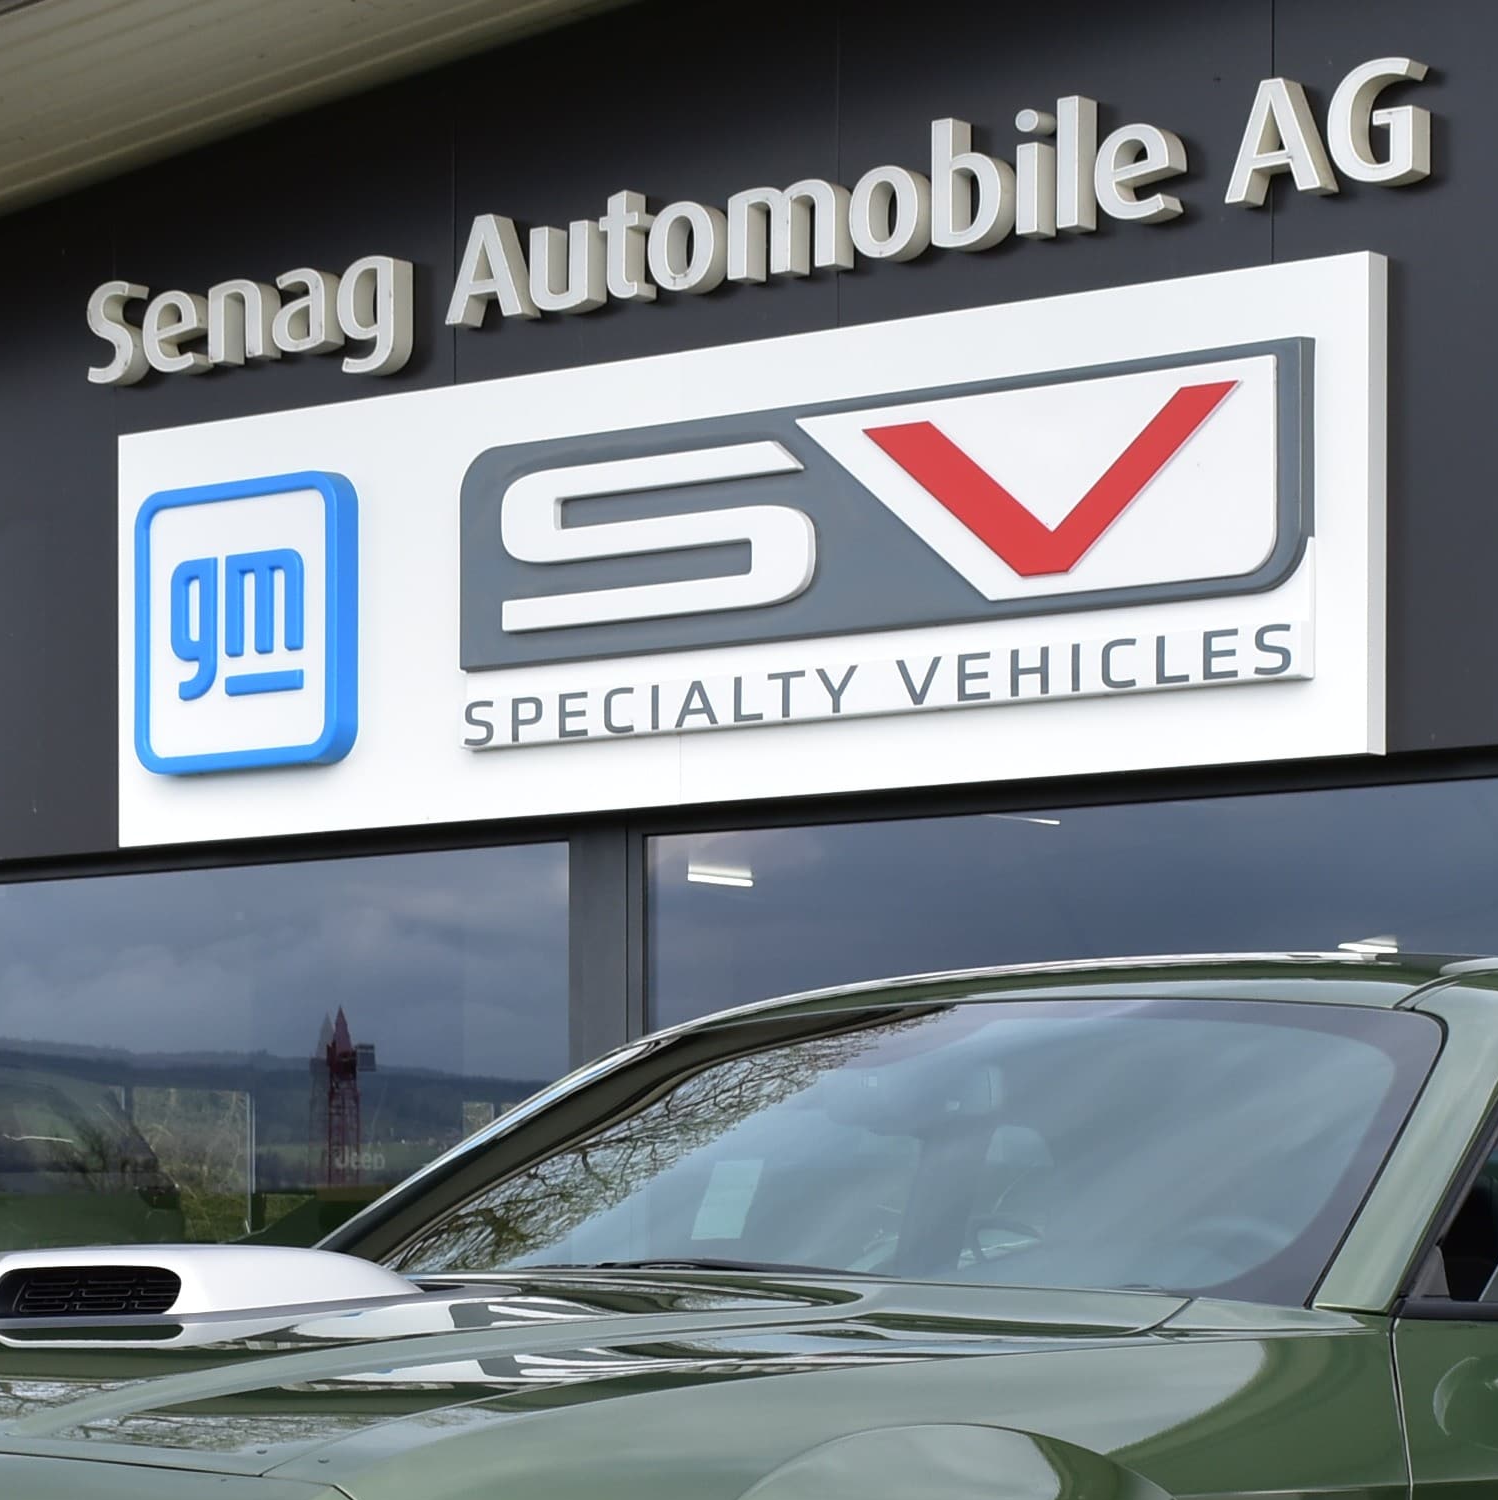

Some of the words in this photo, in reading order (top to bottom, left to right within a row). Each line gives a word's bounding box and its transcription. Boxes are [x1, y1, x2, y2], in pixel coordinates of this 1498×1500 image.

[86, 254, 414, 386] Senag
[447, 95, 1188, 330] Automobile
[1225, 56, 1431, 206] AG
[170, 546, 305, 702] gm
[463, 662, 859, 748] SPECIALTY
[903, 622, 1295, 707] VEHICLES
